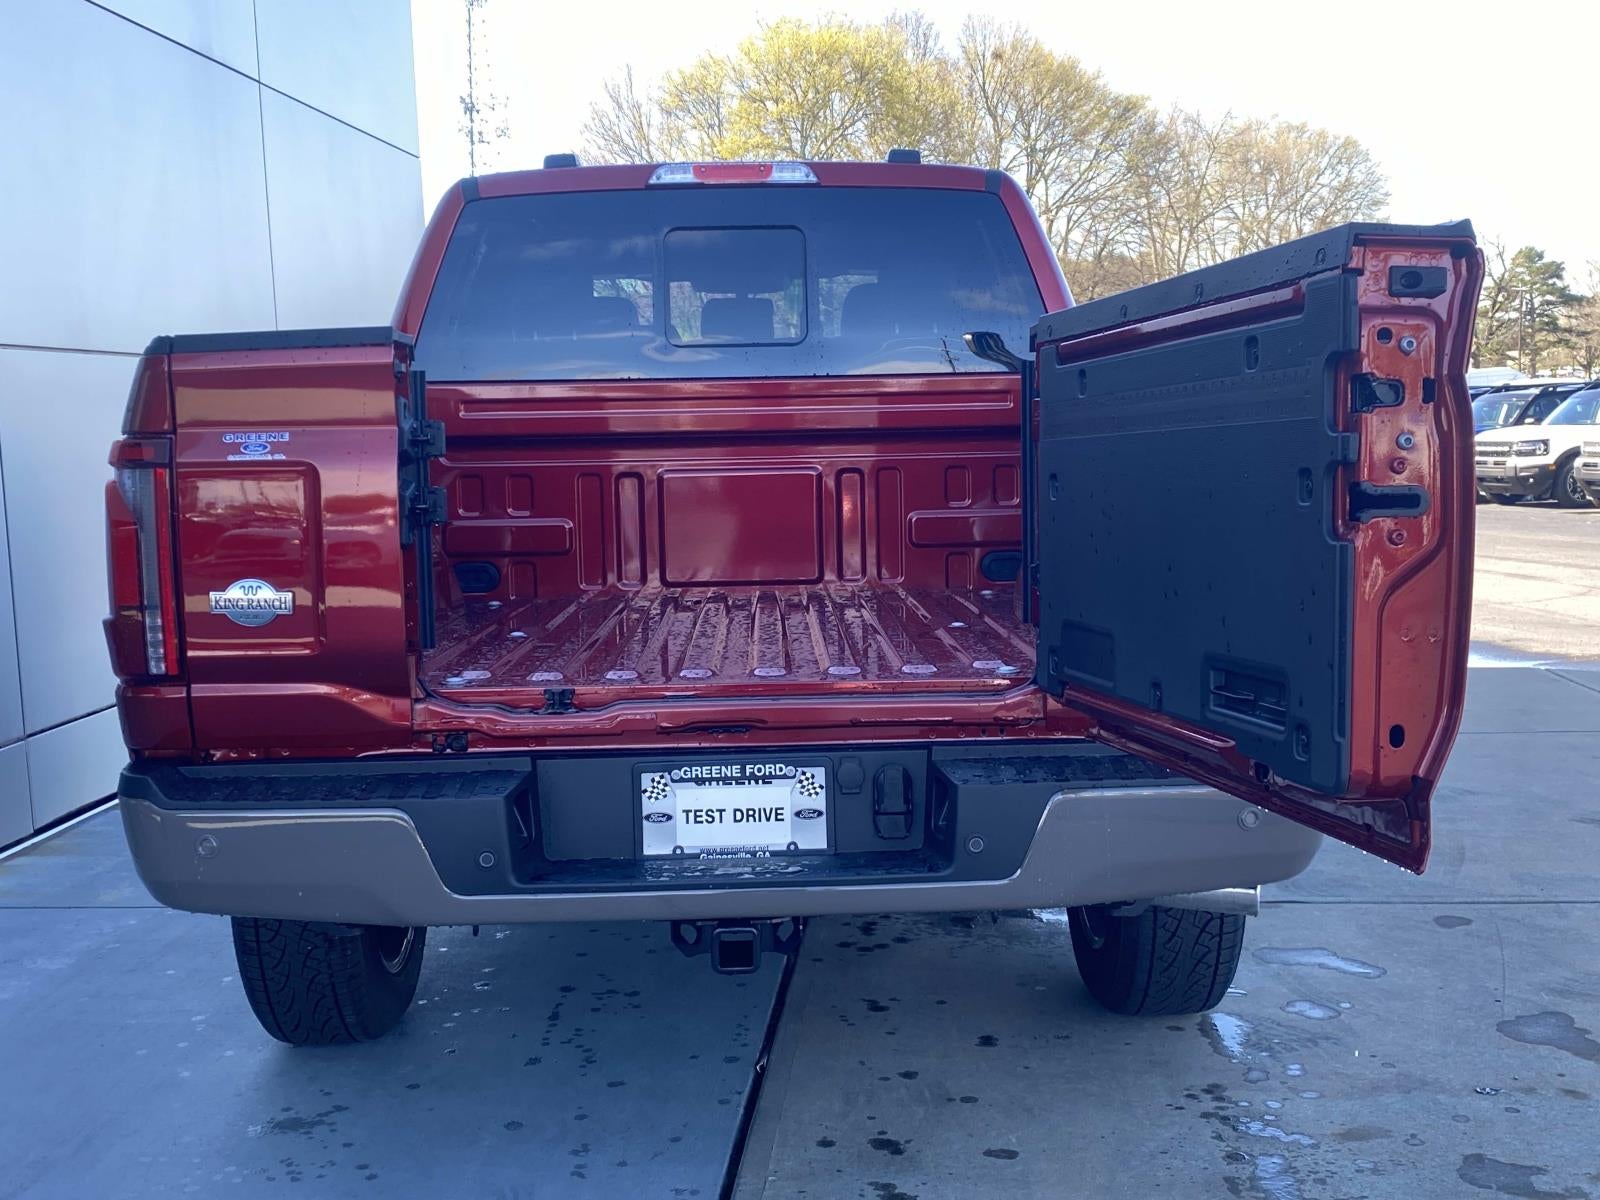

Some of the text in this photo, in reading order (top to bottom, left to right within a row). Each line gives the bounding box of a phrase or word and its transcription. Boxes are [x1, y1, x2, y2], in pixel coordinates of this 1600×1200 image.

[222, 431, 290, 443] GREENE
[213, 596, 288, 610] KING RANCH
[680, 763, 786, 779] GREENE FORD
[648, 813, 669, 823] Ford
[681, 807, 785, 825] TEST DRIVE
[798, 808, 818, 819] Ford
